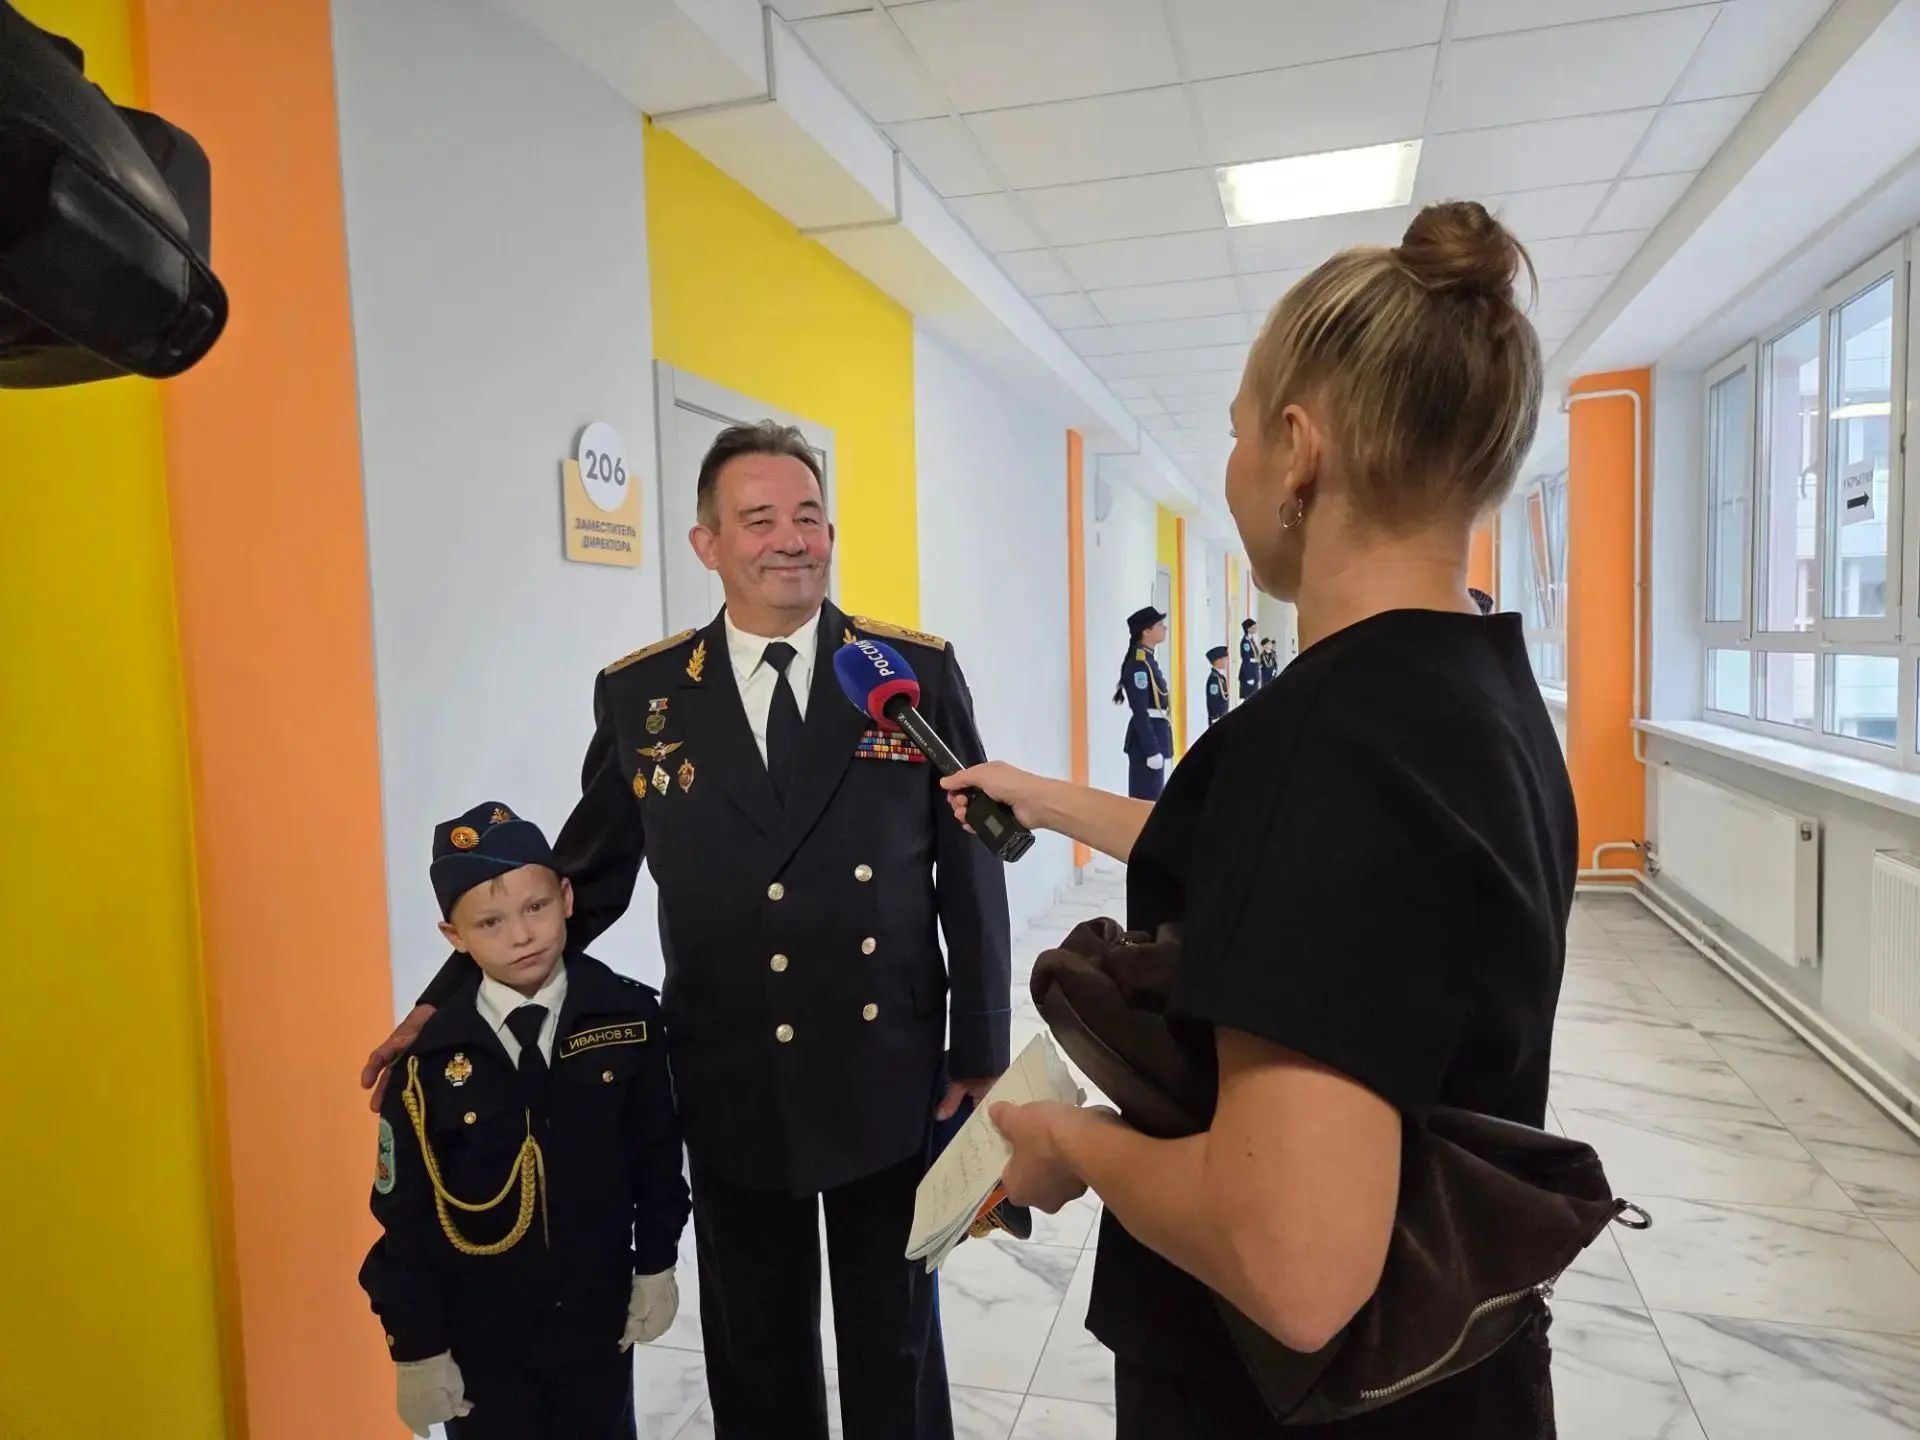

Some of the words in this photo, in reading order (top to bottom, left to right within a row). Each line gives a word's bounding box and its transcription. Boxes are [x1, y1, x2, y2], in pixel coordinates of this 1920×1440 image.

[585, 450, 626, 486] 206
[575, 517, 636, 537] ЗАМЕСТИТЕЛЬ
[582, 535, 632, 552] ДИРЕКТОРА
[854, 640, 895, 676] РОССИЯ
[569, 1030, 622, 1050] ИВАНОВ
[624, 1028, 637, 1038] Я.
